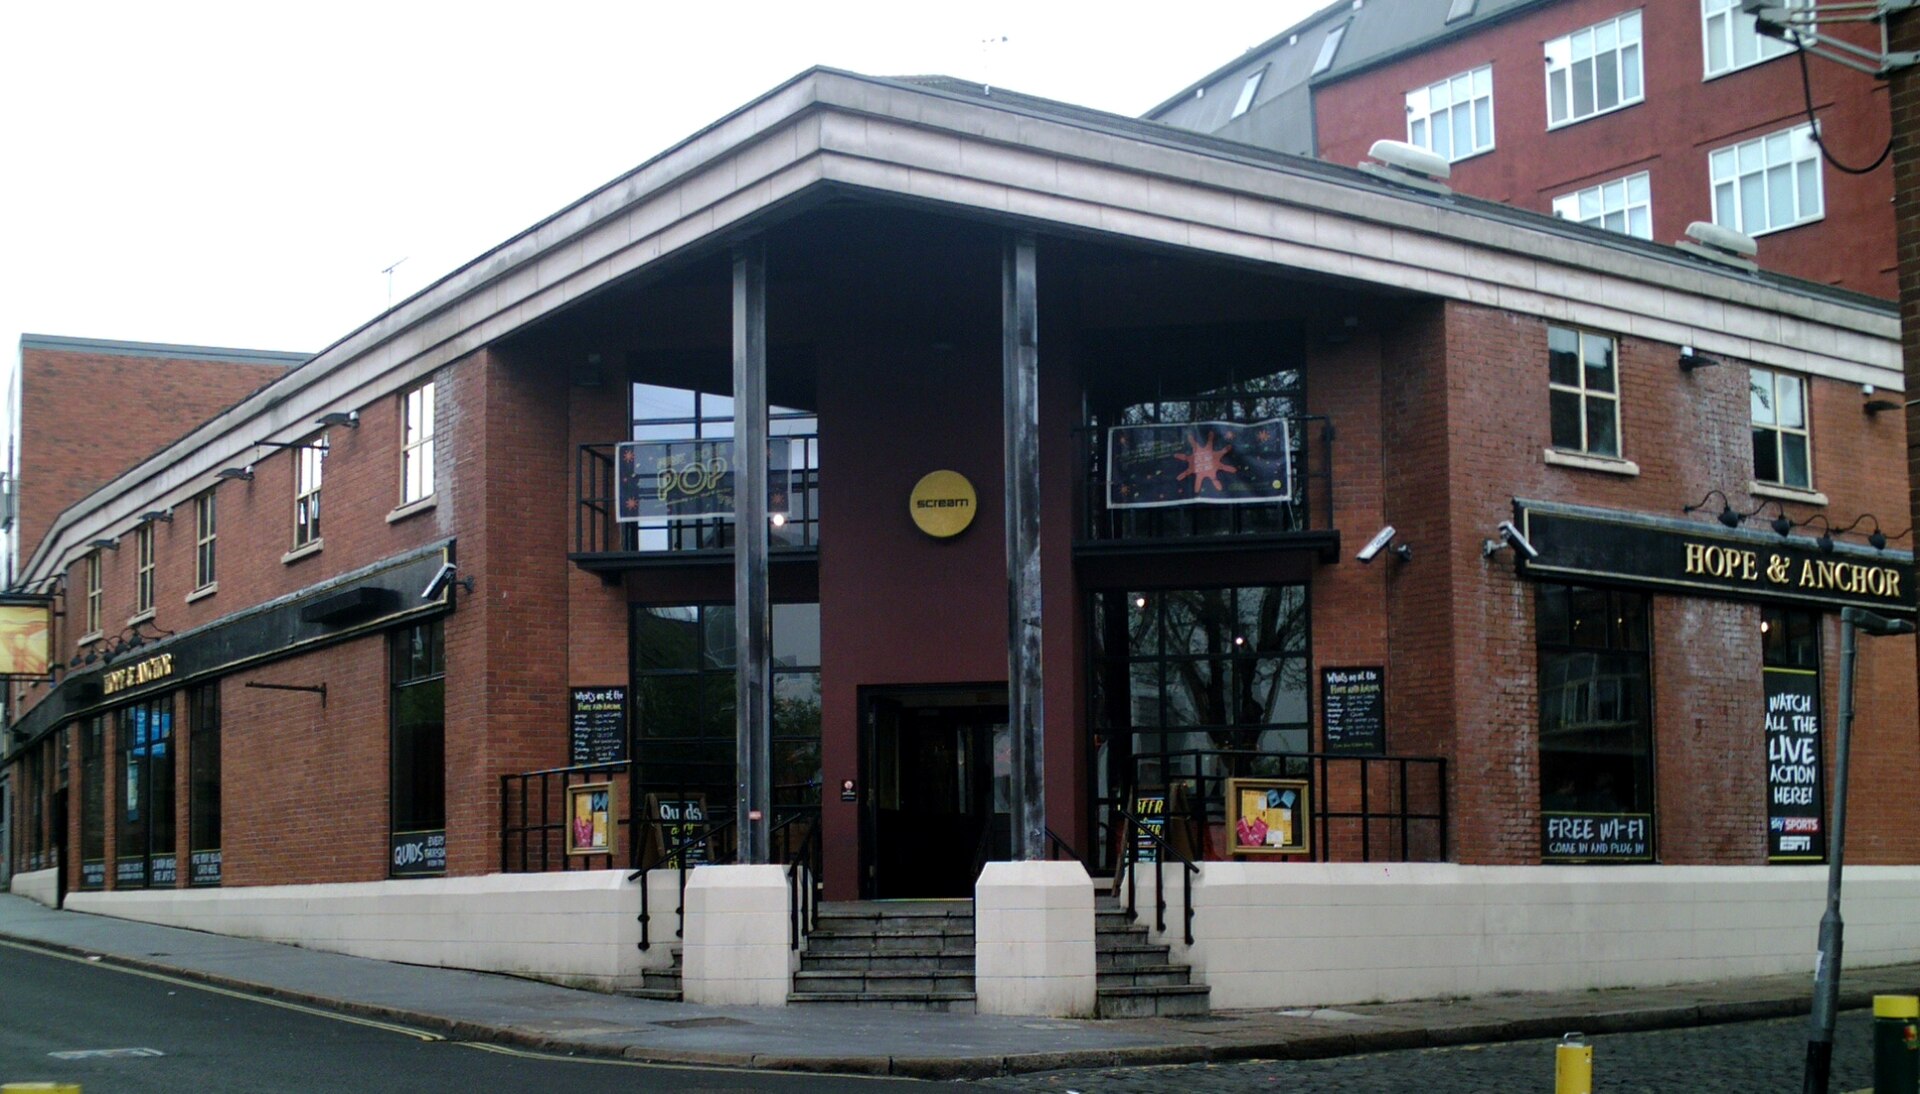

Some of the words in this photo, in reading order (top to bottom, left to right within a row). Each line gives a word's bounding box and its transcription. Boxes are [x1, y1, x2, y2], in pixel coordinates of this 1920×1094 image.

[658, 457, 728, 501] POP
[917, 499, 969, 508] scream
[1684, 543, 1758, 581] HOPE
[1766, 554, 1790, 584] &
[1799, 559, 1901, 598] ANCHOR
[1769, 693, 1811, 713] WATCH
[1765, 712, 1788, 732] ALL
[1792, 715, 1818, 735] THE
[1769, 734, 1816, 765] LIVE
[1770, 763, 1816, 784] ACTION
[1774, 786, 1813, 805] HERE!
[660, 803, 702, 821] Quds
[1548, 818, 1595, 840] FREE
[1600, 818, 1644, 842] WI-FI
[1785, 818, 1819, 831] SPORTS
[1549, 843, 1577, 854] COME
[1579, 843, 1588, 853] IN
[1590, 842, 1608, 854] AND
[1610, 842, 1632, 854] PLUG
[1635, 843, 1645, 853] IN
[1780, 836, 1811, 851] ESPN
[394, 842, 424, 866] QUIDS
